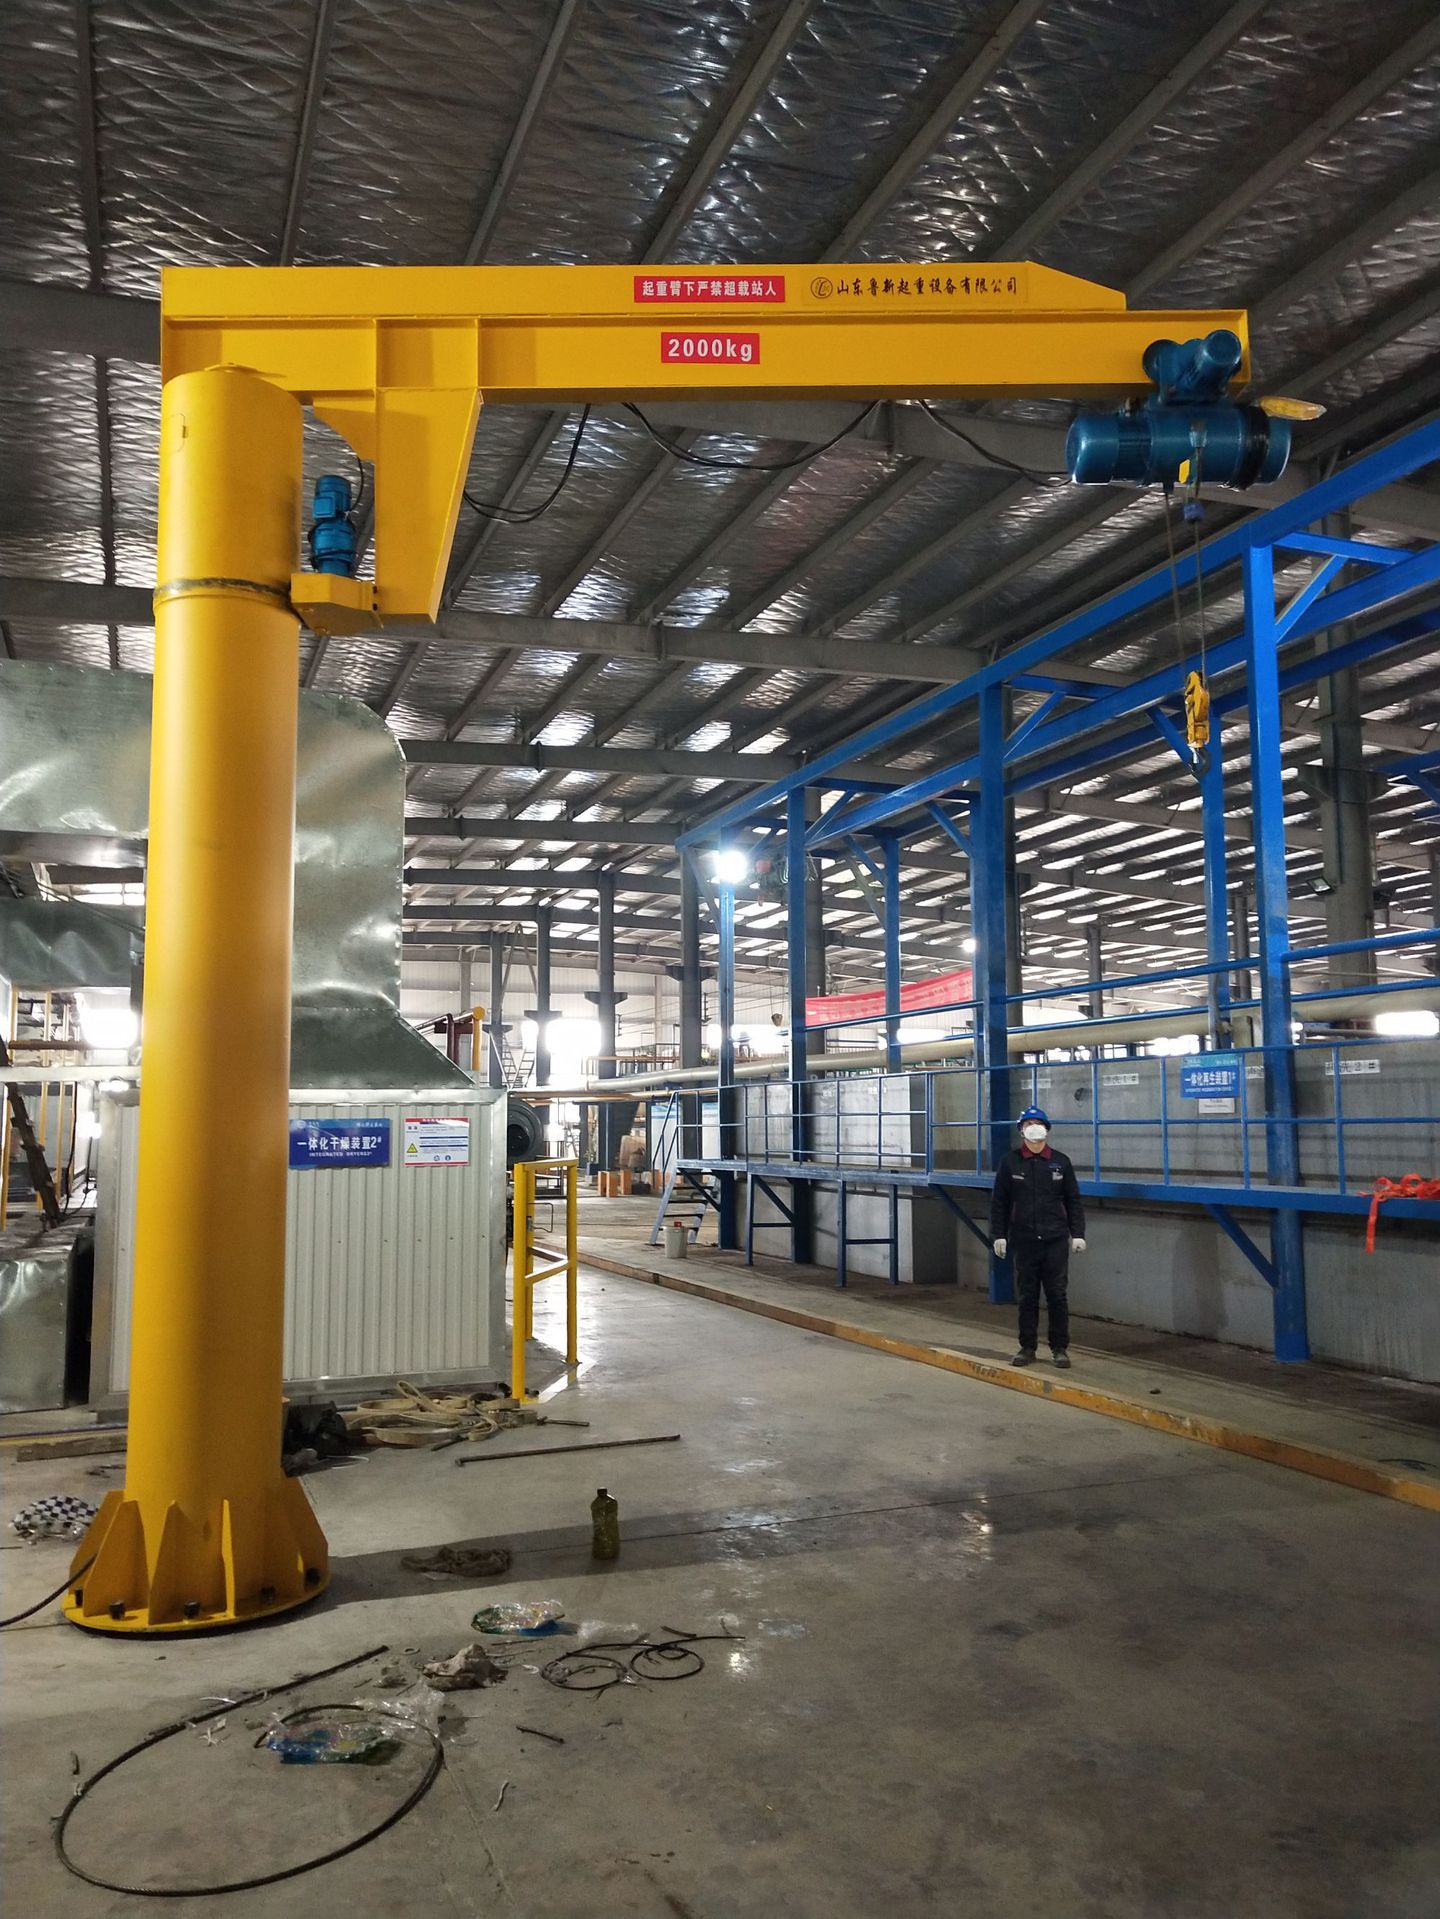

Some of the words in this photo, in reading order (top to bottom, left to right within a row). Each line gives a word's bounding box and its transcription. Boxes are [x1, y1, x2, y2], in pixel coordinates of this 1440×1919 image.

[642, 280, 777, 297] 起重臂下严禁超载站人
[837, 276, 1017, 296] 山东鲁新起重设备有限公司
[668, 338, 753, 362] 2000kg
[297, 1136, 382, 1151] 一体化干燥装置2#
